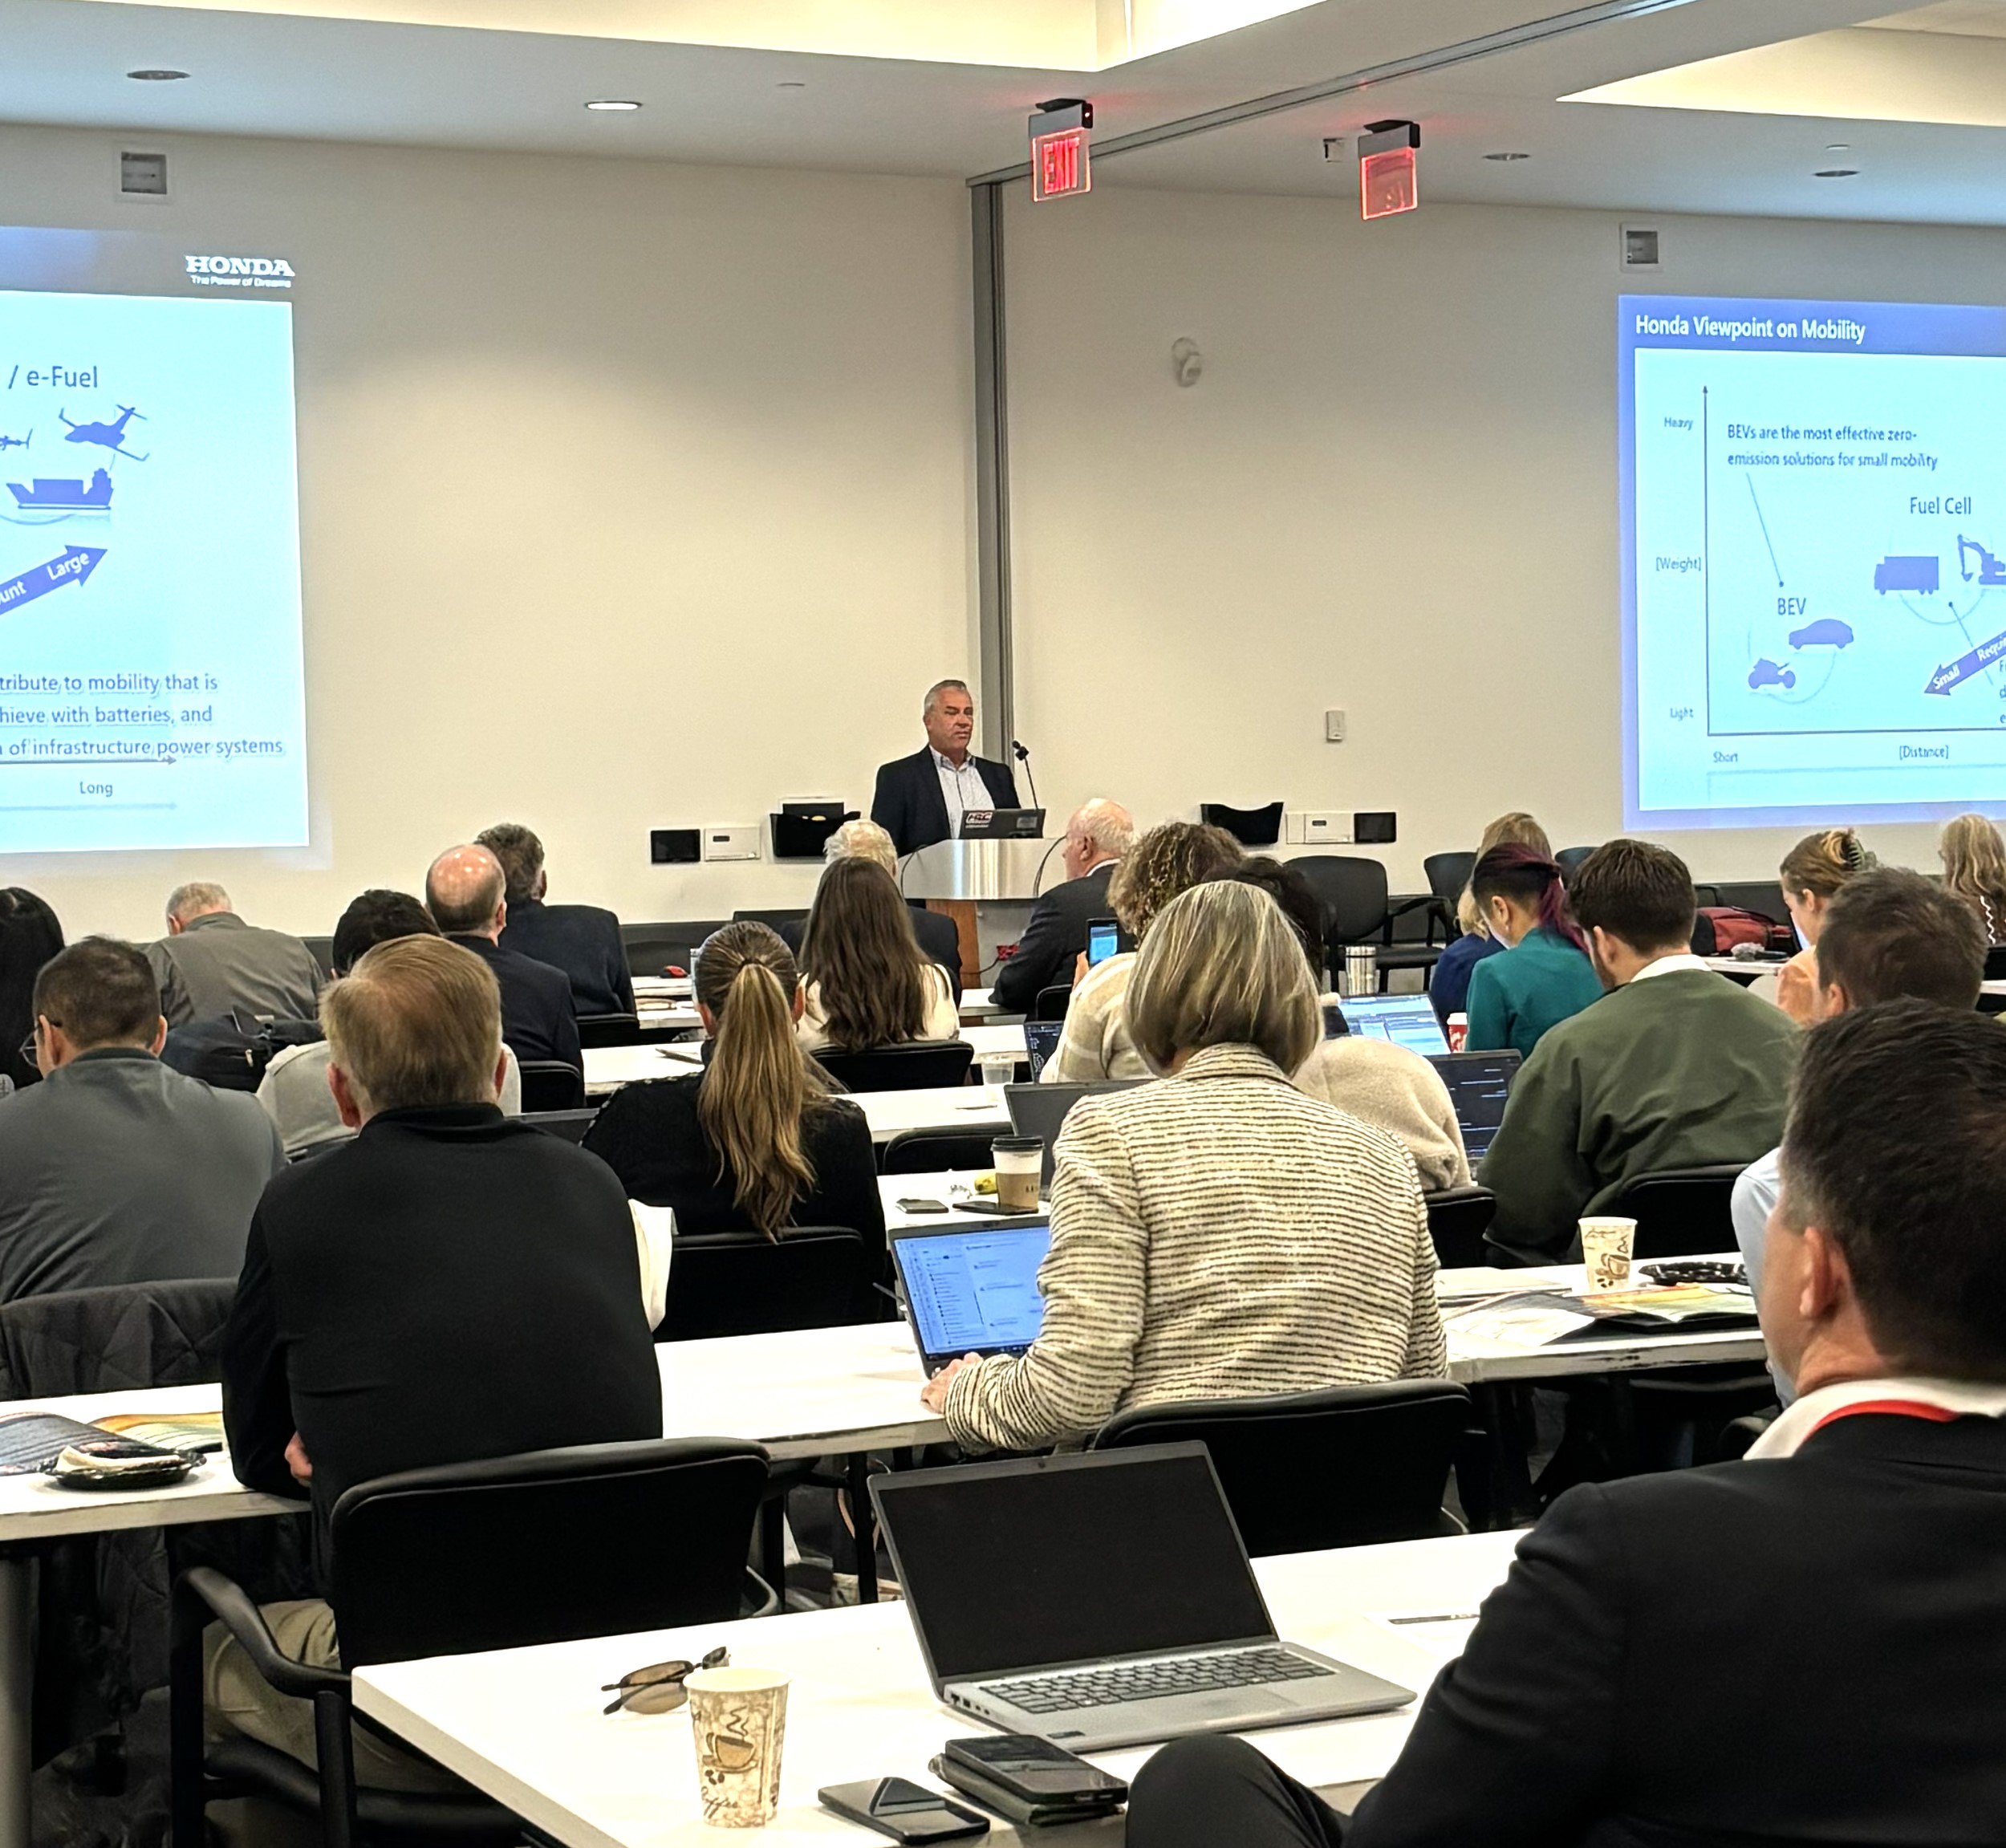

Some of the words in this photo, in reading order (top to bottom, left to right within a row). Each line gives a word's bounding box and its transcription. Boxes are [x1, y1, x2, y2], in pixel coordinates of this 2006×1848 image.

[1043, 137, 1080, 194] EXIT
[185, 255, 295, 277] HONDA
[242, 278, 253, 286] of
[1635, 315, 1689, 335] Honda
[1693, 316, 1773, 341] Viewpoint
[1777, 321, 1797, 338] on
[1802, 319, 1866, 344] Mobility
[8, 365, 18, 389] /
[26, 366, 98, 388] e-Fuel
[1664, 416, 1693, 431] Heavy
[1728, 424, 1756, 439] BEVs
[1759, 428, 1778, 439] are
[1781, 425, 1801, 440] the
[1804, 428, 1833, 440] most
[1835, 426, 1884, 441] effective
[1887, 429, 1917, 441] zero-
[1728, 451, 1780, 465] emission
[1783, 452, 1835, 466] solutions
[1838, 452, 1855, 466] for
[1858, 453, 1888, 466] small
[1891, 453, 1938, 471] mobility
[1910, 496, 1940, 515] Fuel
[1945, 497, 1972, 515] Cell
[0, 580, 27, 603] unt
[47, 553, 90, 580] Large
[1777, 598, 1806, 615] BEV
[64, 676, 82, 691] to
[88, 672, 160, 694] mobility
[165, 673, 199, 690] that
[205, 672, 218, 690] is
[1932, 664, 1960, 689] Small
[51, 706, 89, 722] with
[95, 705, 175, 725] batteries,
[181, 705, 213, 722] and
[1670, 707, 1694, 721] Light
[9, 738, 27, 756] of
[33, 738, 151, 756] infrastructure
[157, 741, 211, 758] power
[216, 740, 283, 759] systems
[1713, 751, 1738, 763] Short
[79, 781, 113, 797] Long
